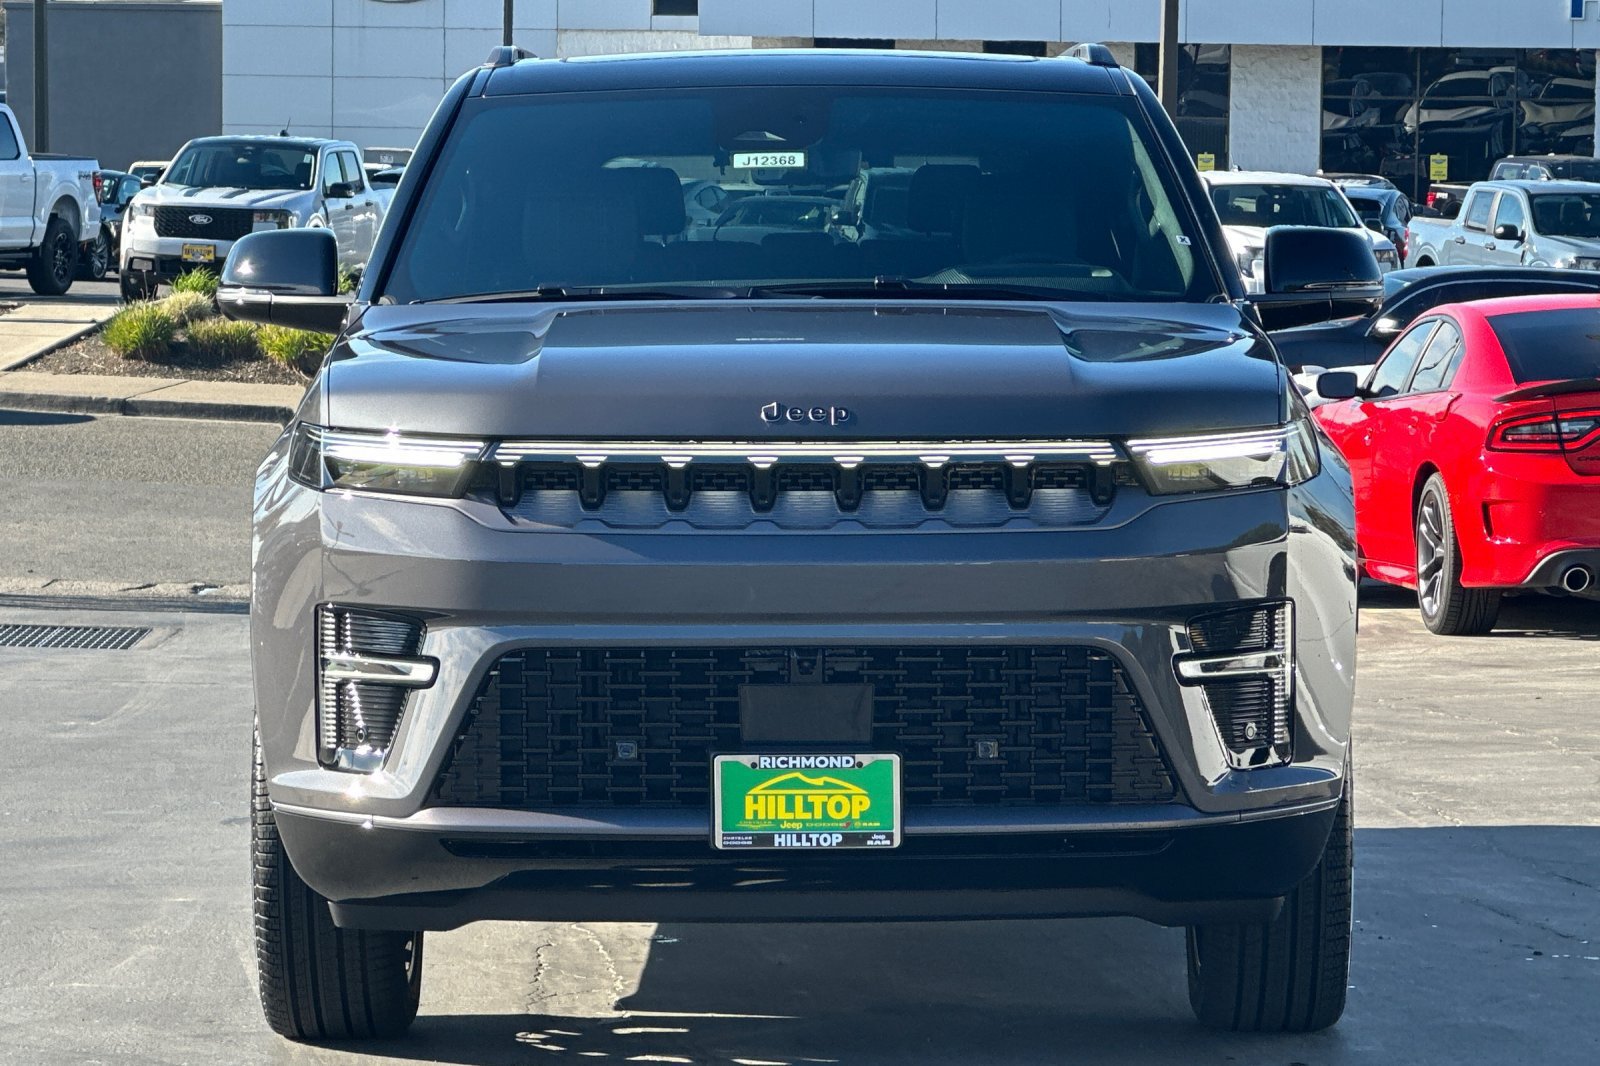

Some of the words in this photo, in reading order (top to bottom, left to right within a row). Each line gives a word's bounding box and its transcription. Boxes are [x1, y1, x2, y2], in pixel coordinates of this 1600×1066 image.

[742, 155, 796, 166] J12368
[760, 401, 850, 426] Jeep
[759, 756, 855, 769] RICHMOND
[744, 795, 871, 820] HILLTOP
[780, 820, 803, 830] Jeep
[773, 833, 843, 847] HILLTOP
[871, 833, 886, 841] Jeep
